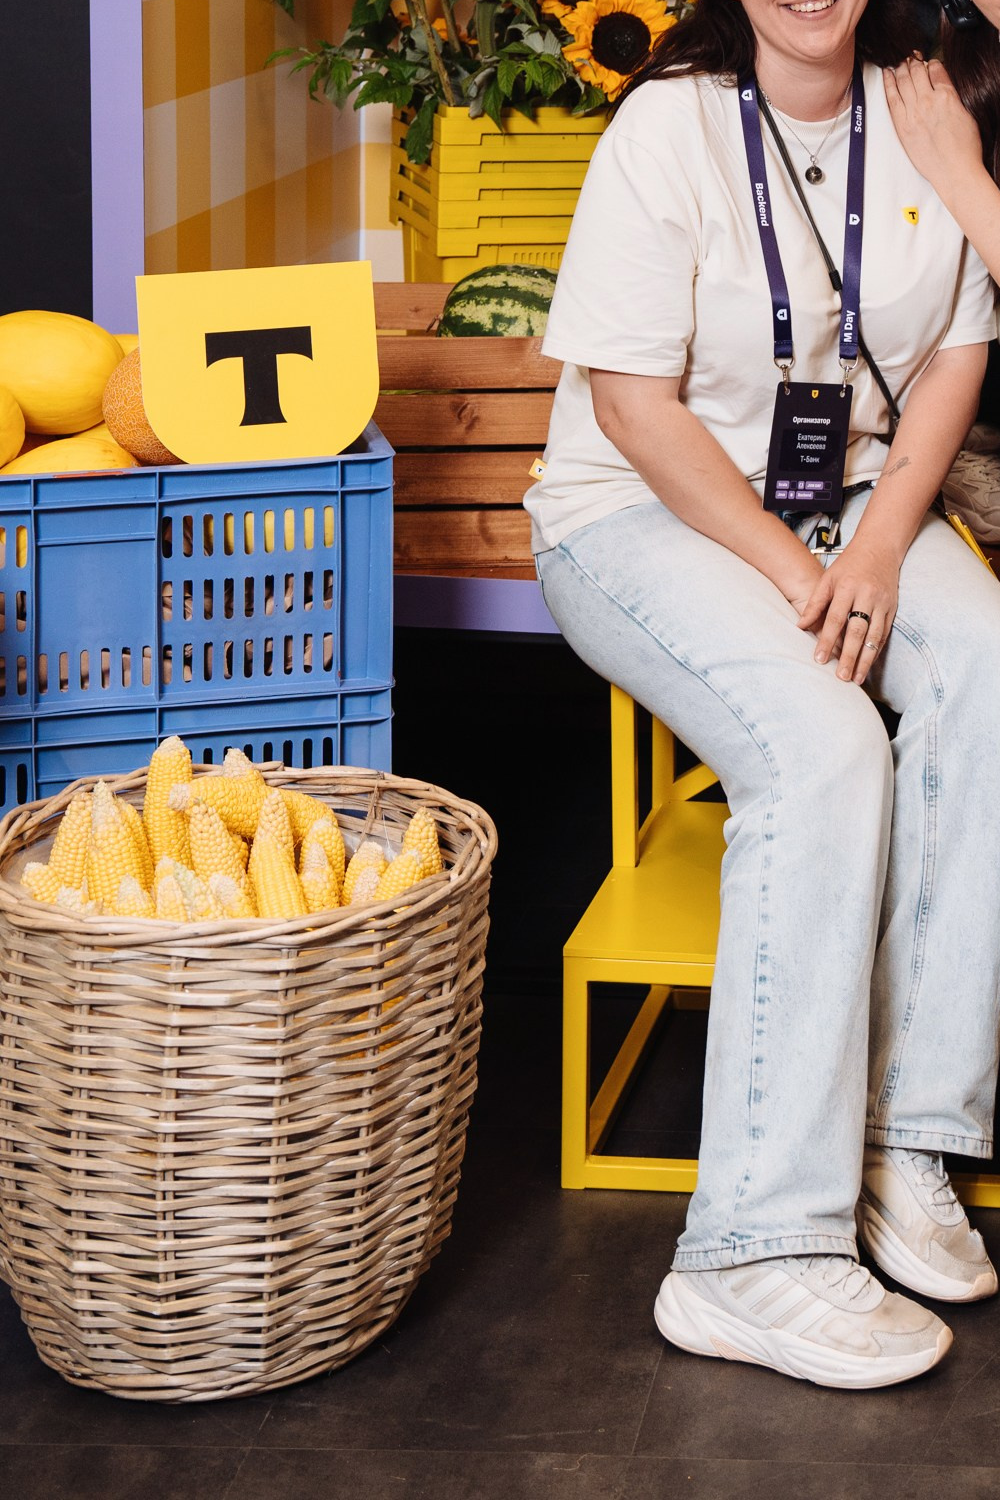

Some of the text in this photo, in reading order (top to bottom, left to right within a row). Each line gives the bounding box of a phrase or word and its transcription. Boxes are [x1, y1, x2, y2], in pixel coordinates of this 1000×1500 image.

[853, 105, 863, 133] Scala
[754, 182, 770, 228] Backend
[843, 309, 856, 330] Day
[205, 326, 313, 427] T
[792, 415, 831, 426] Организатор
[797, 433, 827, 443] Екатерина
[796, 442, 827, 451] Алексеева
[800, 455, 820, 463] Т-Банк
